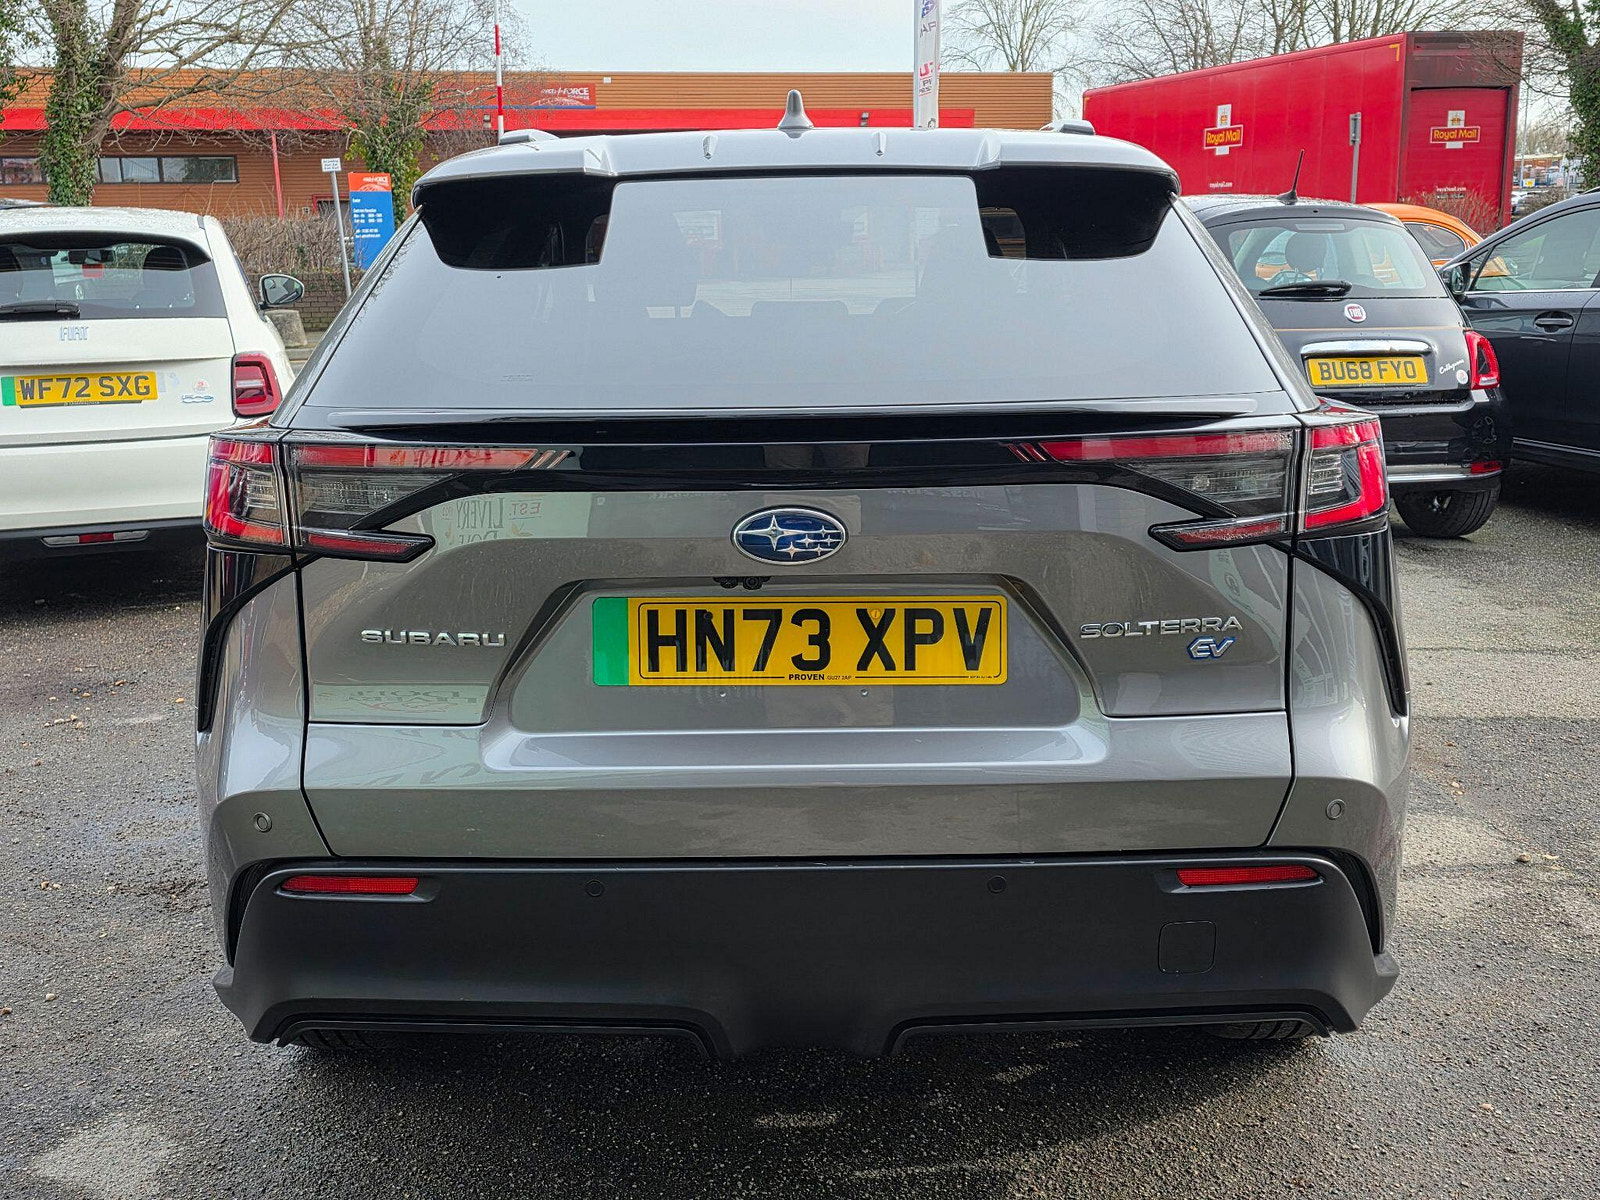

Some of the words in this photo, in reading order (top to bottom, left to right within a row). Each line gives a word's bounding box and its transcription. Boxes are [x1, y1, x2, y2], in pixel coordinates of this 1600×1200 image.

[1206, 131, 1226, 146] Royal
[1225, 129, 1241, 143] Mail
[1433, 129, 1457, 140] Royal
[1458, 129, 1477, 139] Mail
[59, 326, 89, 341] FIAT
[1317, 361, 1373, 381] BU68
[1377, 360, 1417, 380] FYO
[19, 376, 91, 400] WF72
[98, 375, 151, 397] SXG
[1080, 616, 1243, 638] SOLTERRA
[360, 629, 507, 648] SUBARU
[646, 608, 831, 673] HN73
[855, 607, 993, 672] XPV
[1188, 637, 1236, 660] EV
[788, 673, 825, 681] PROVEN
